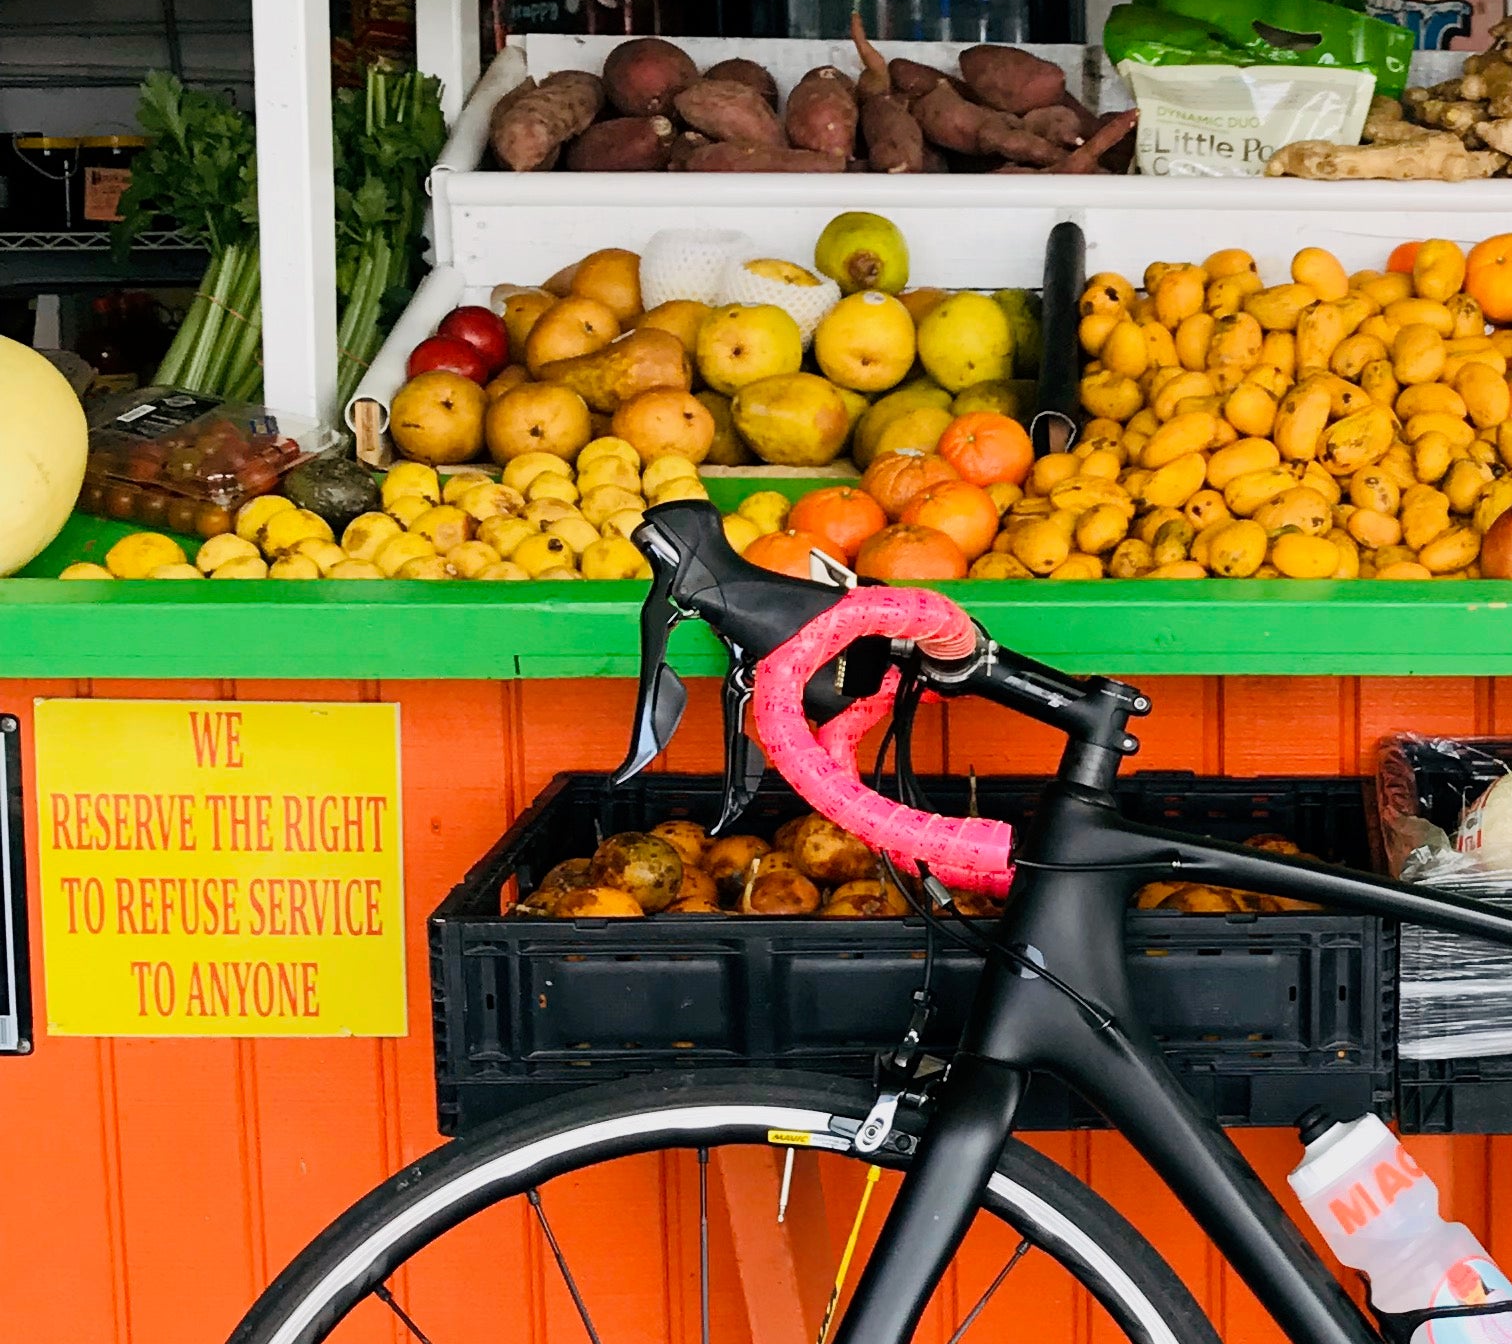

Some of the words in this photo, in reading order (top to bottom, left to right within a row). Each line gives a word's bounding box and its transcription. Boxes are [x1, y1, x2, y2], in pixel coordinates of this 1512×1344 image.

[1154, 127, 1234, 158] Little
[189, 711, 244, 768] WE
[50, 793, 197, 851] RESERVE
[205, 794, 274, 852] THE
[284, 795, 387, 853] RIGHT
[61, 877, 105, 934] TO
[116, 878, 240, 935] REFUSE
[249, 879, 383, 936] SERVICE
[131, 961, 175, 1017] TO
[185, 961, 320, 1018] ANYONE
